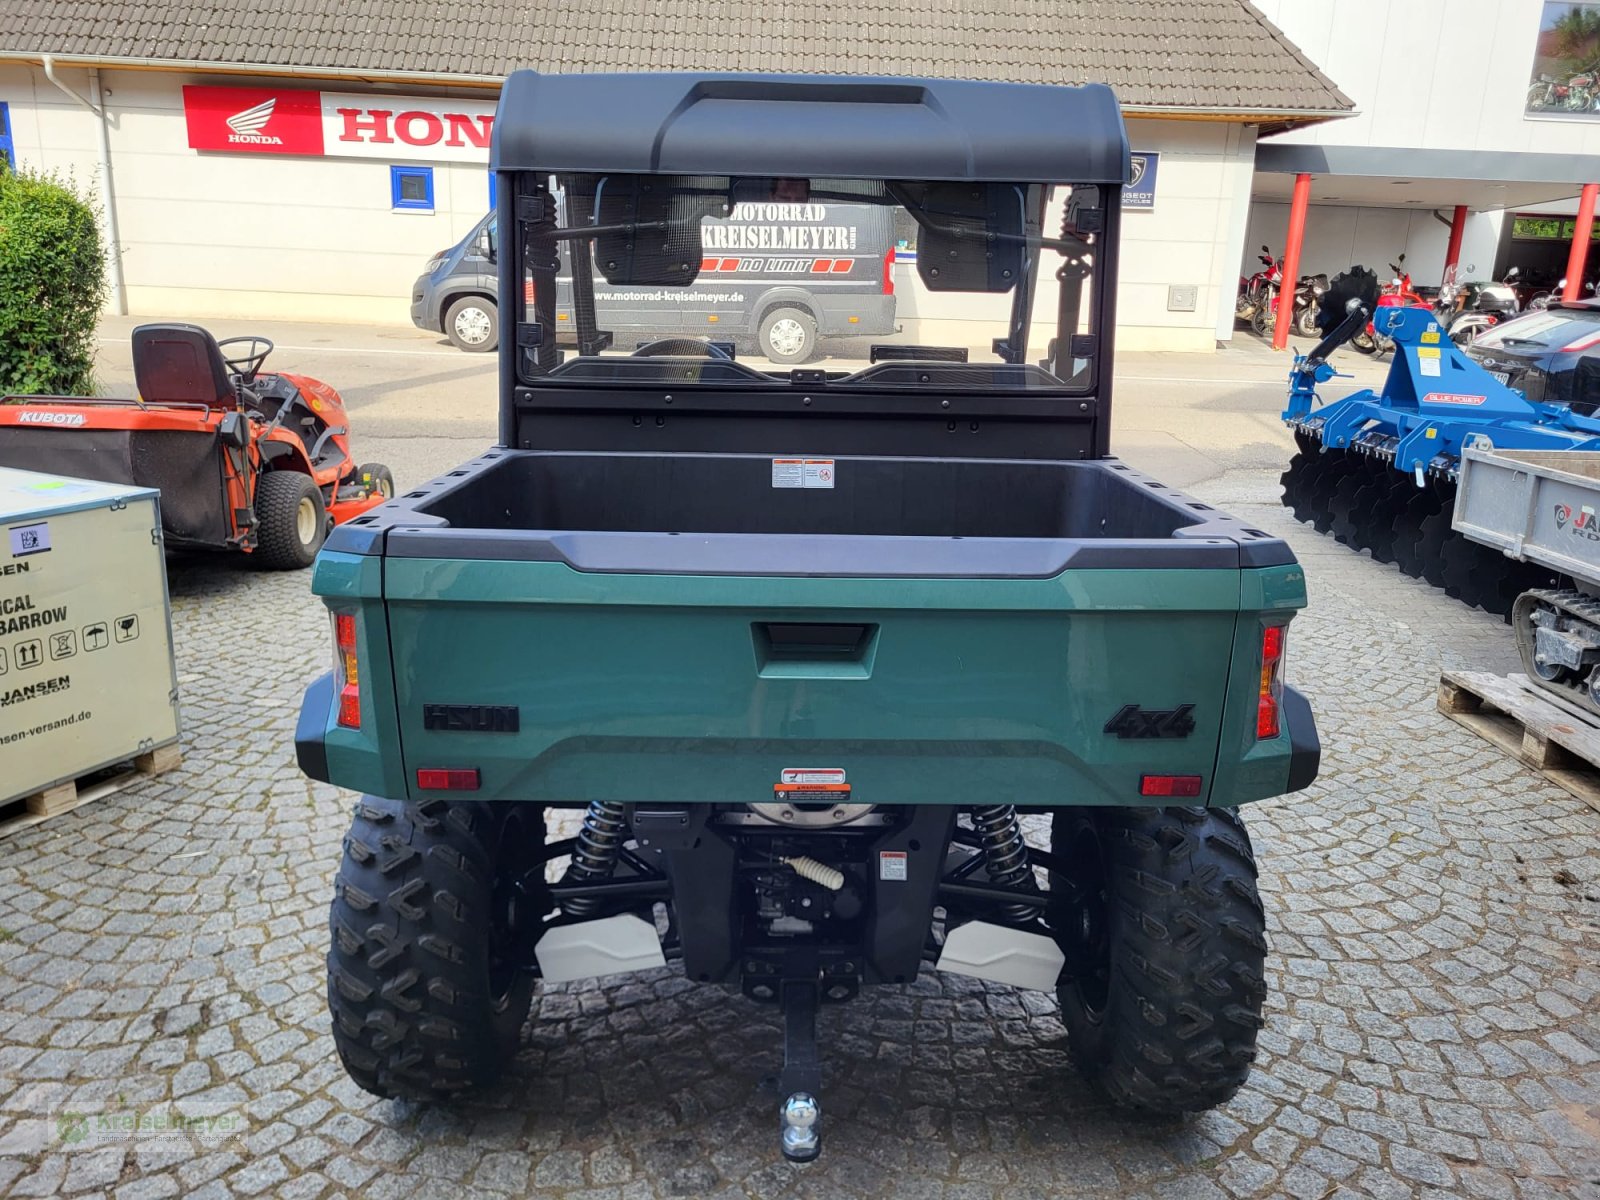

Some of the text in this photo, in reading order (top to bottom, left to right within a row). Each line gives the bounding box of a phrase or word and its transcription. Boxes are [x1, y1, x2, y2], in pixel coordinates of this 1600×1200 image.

[336, 107, 495, 148] HON
[228, 134, 283, 145] HONDA
[730, 204, 825, 222] MOTORRAD
[701, 225, 849, 250] KREISELMEYER
[764, 258, 811, 273] LIMIT
[1453, 395, 1480, 404] POWER
[20, 412, 83, 425] KUBOTA
[0, 606, 67, 636] BARROW
[0, 675, 70, 702] JANSEN
